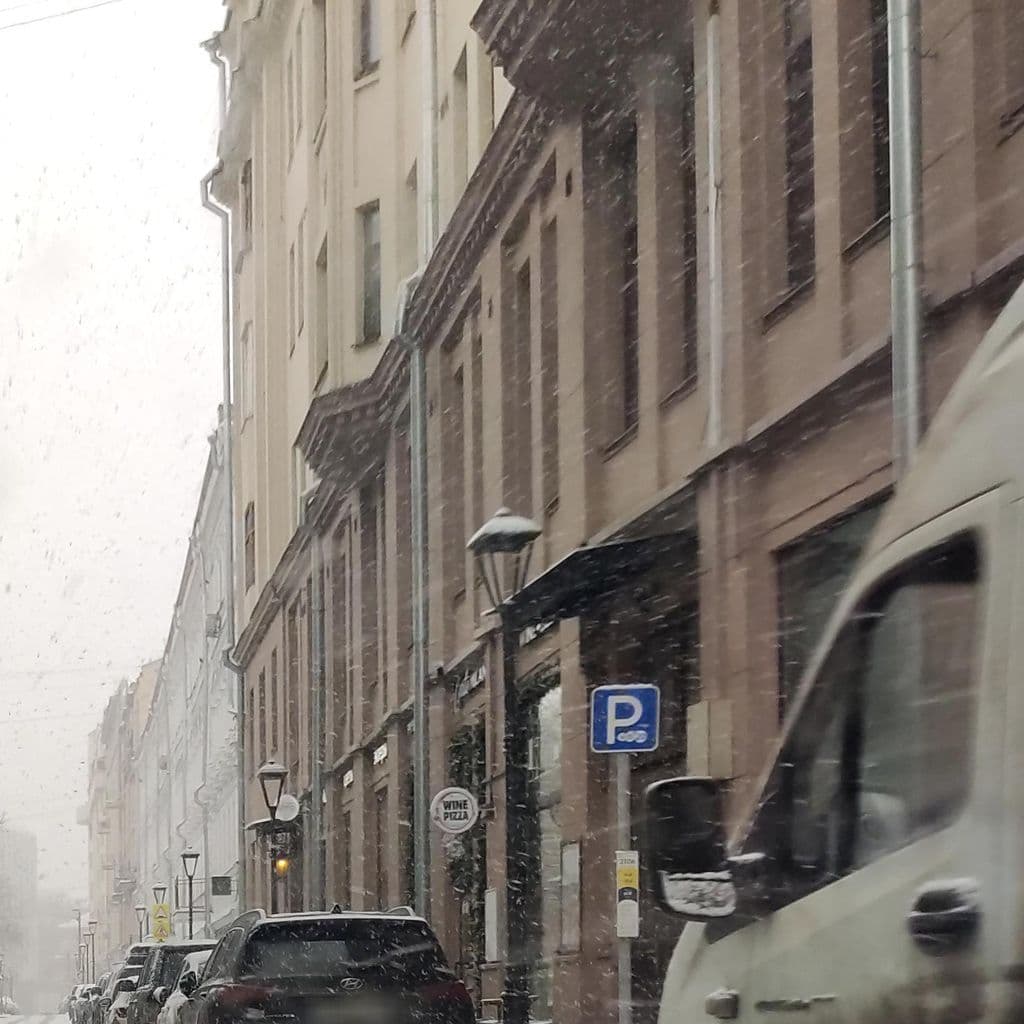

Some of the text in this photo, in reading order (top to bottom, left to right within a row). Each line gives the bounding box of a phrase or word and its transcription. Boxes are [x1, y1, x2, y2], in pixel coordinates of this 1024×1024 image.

[606, 695, 643, 745] P
[443, 800, 469, 810] WINE
[443, 811, 469, 821] PIZZA
